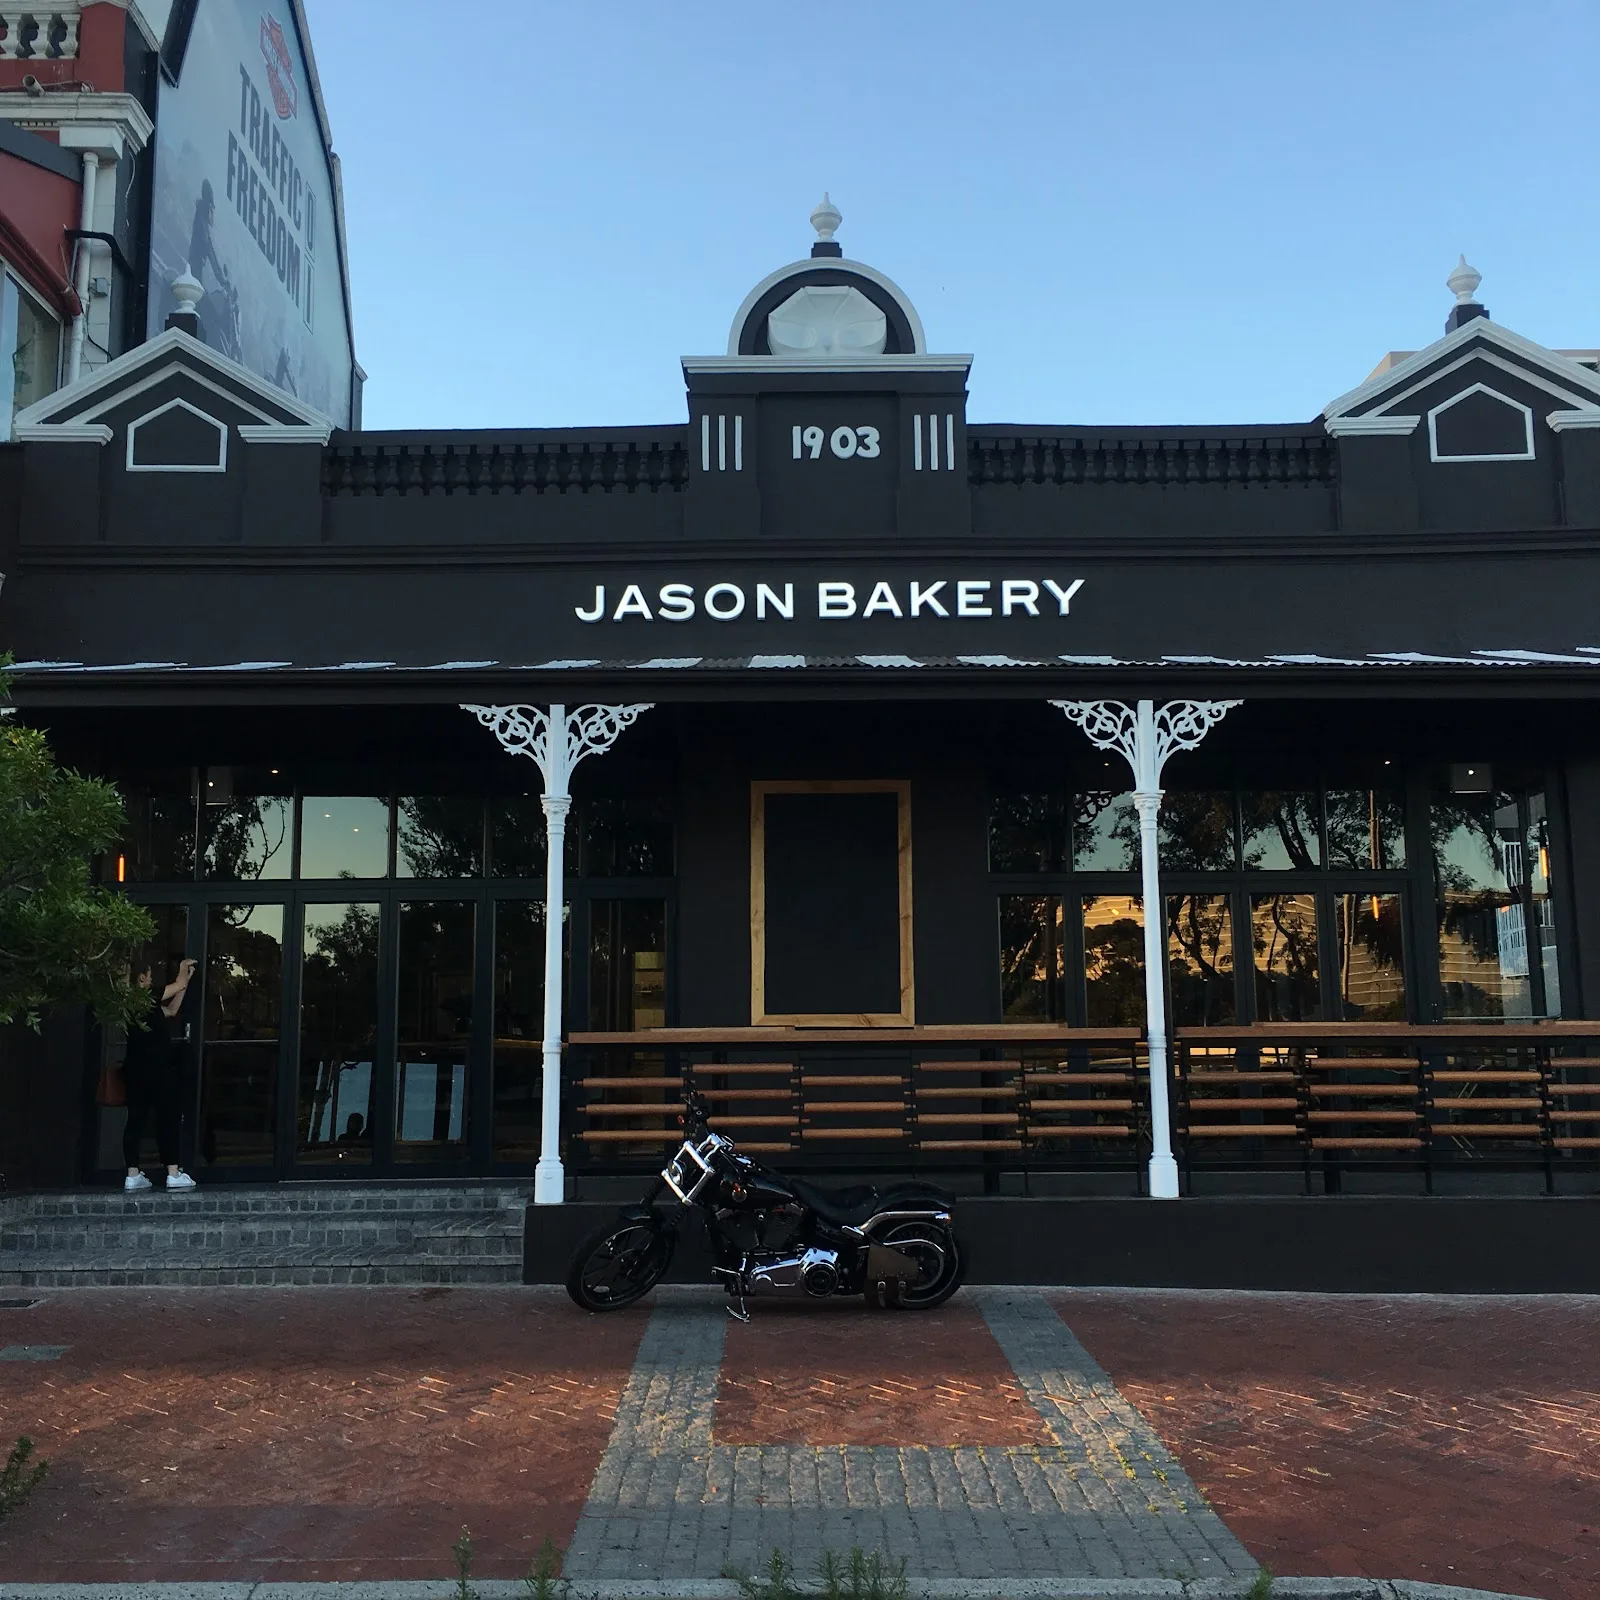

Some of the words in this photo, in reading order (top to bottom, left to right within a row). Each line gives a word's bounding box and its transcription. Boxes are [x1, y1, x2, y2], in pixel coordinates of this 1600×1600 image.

[239, 61, 302, 232] TRAFFIC
[226, 129, 300, 309] FREEDOM
[792, 425, 881, 460] 1903
[574, 582, 795, 623] JASON
[817, 578, 1085, 619] BAKERY
